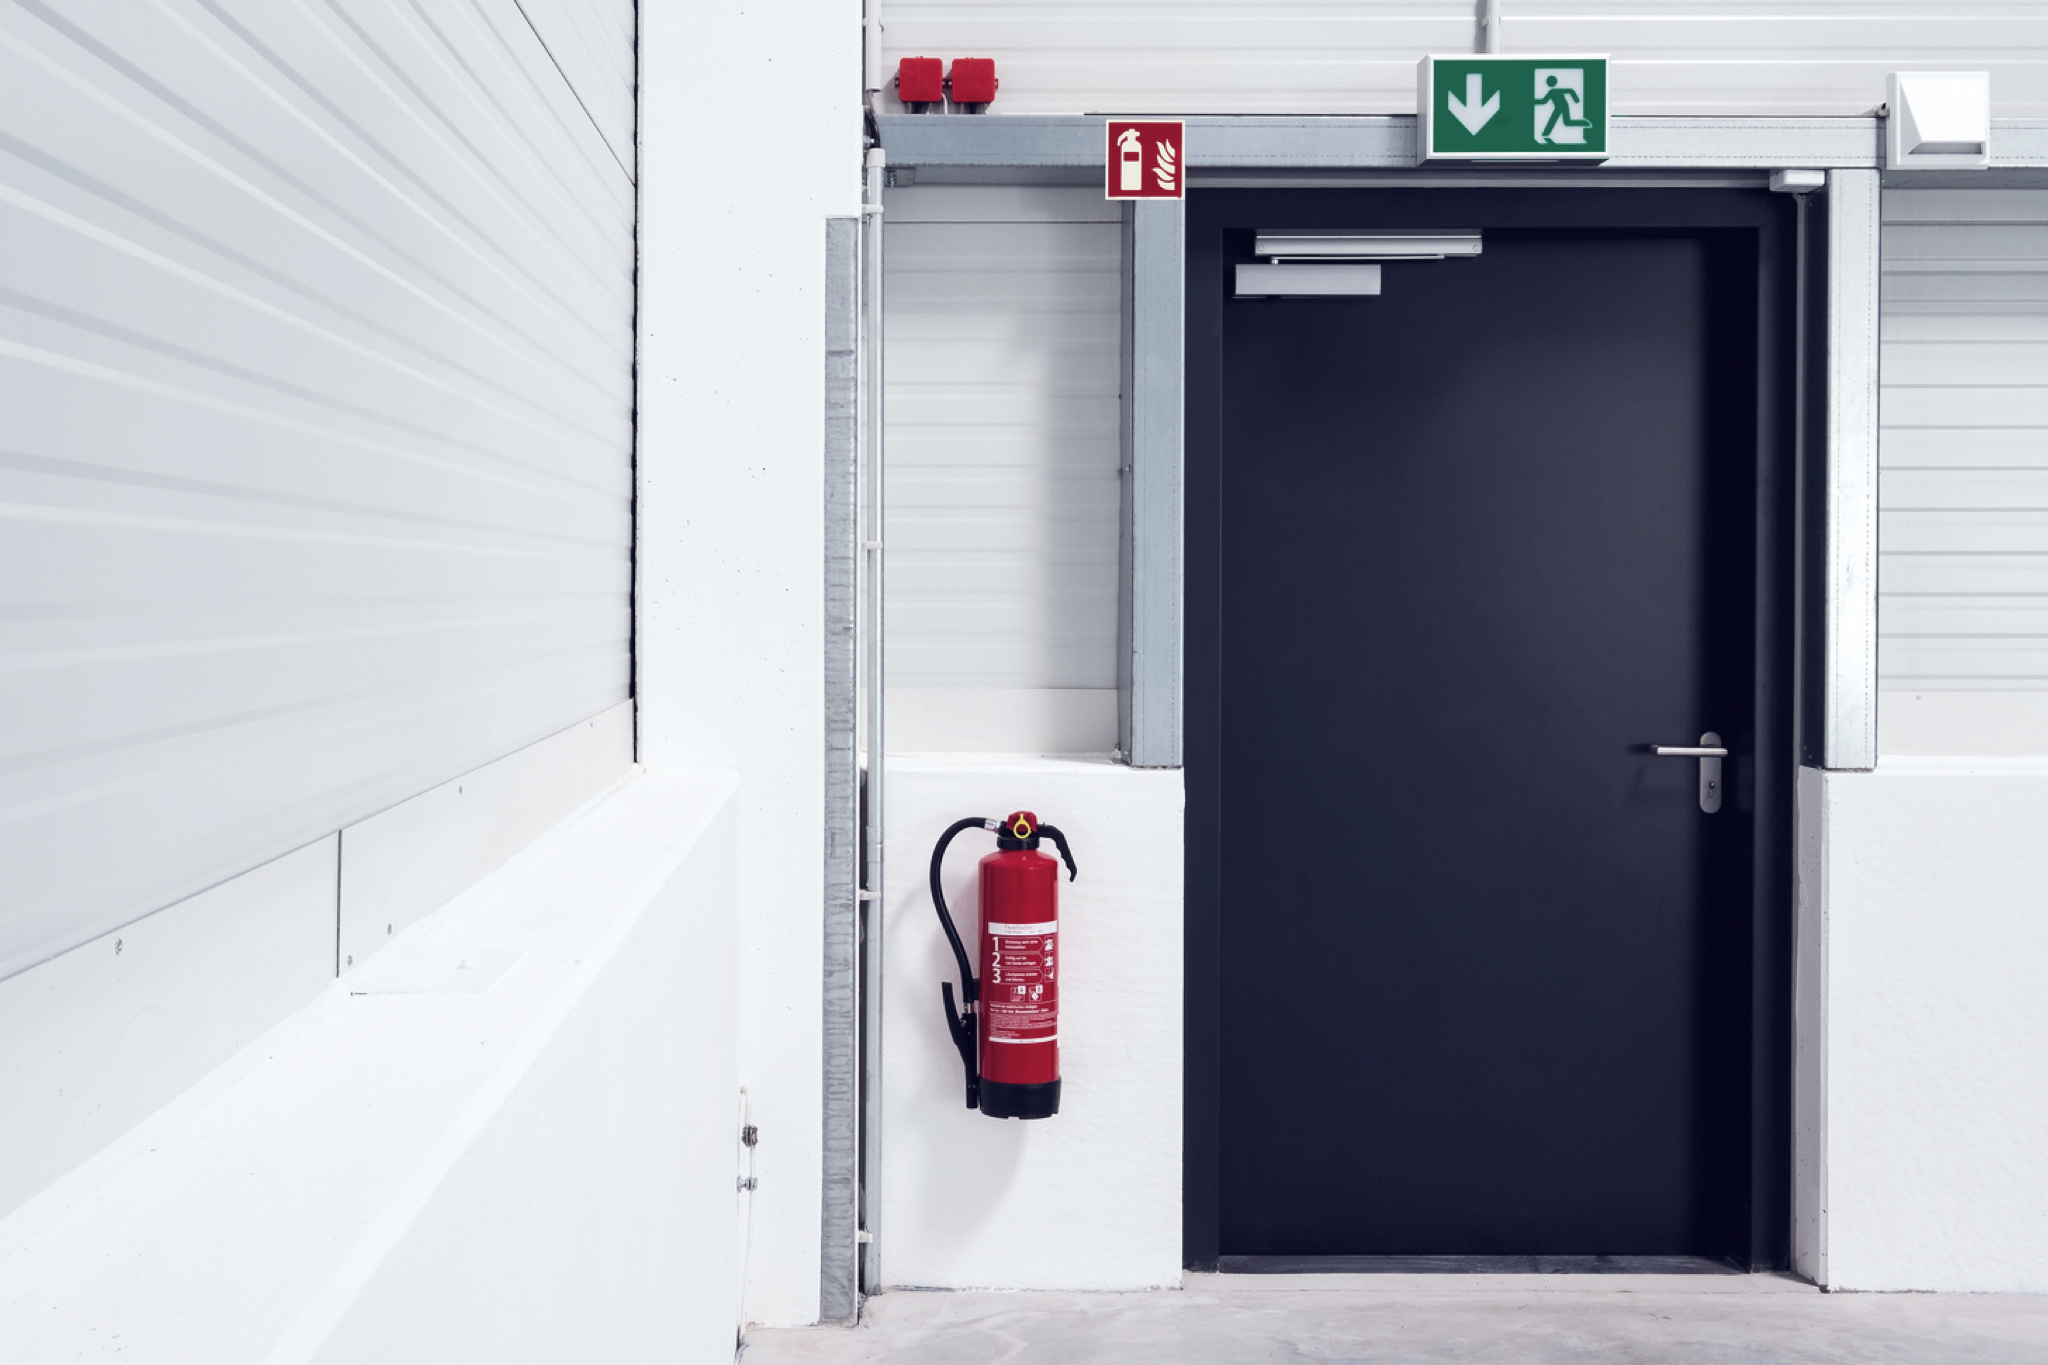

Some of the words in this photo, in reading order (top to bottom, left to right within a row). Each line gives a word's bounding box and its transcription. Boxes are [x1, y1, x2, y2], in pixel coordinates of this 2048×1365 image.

[992, 937, 999, 951] 1
[992, 952, 1001, 967] 2
[992, 968, 1001, 983] 3
